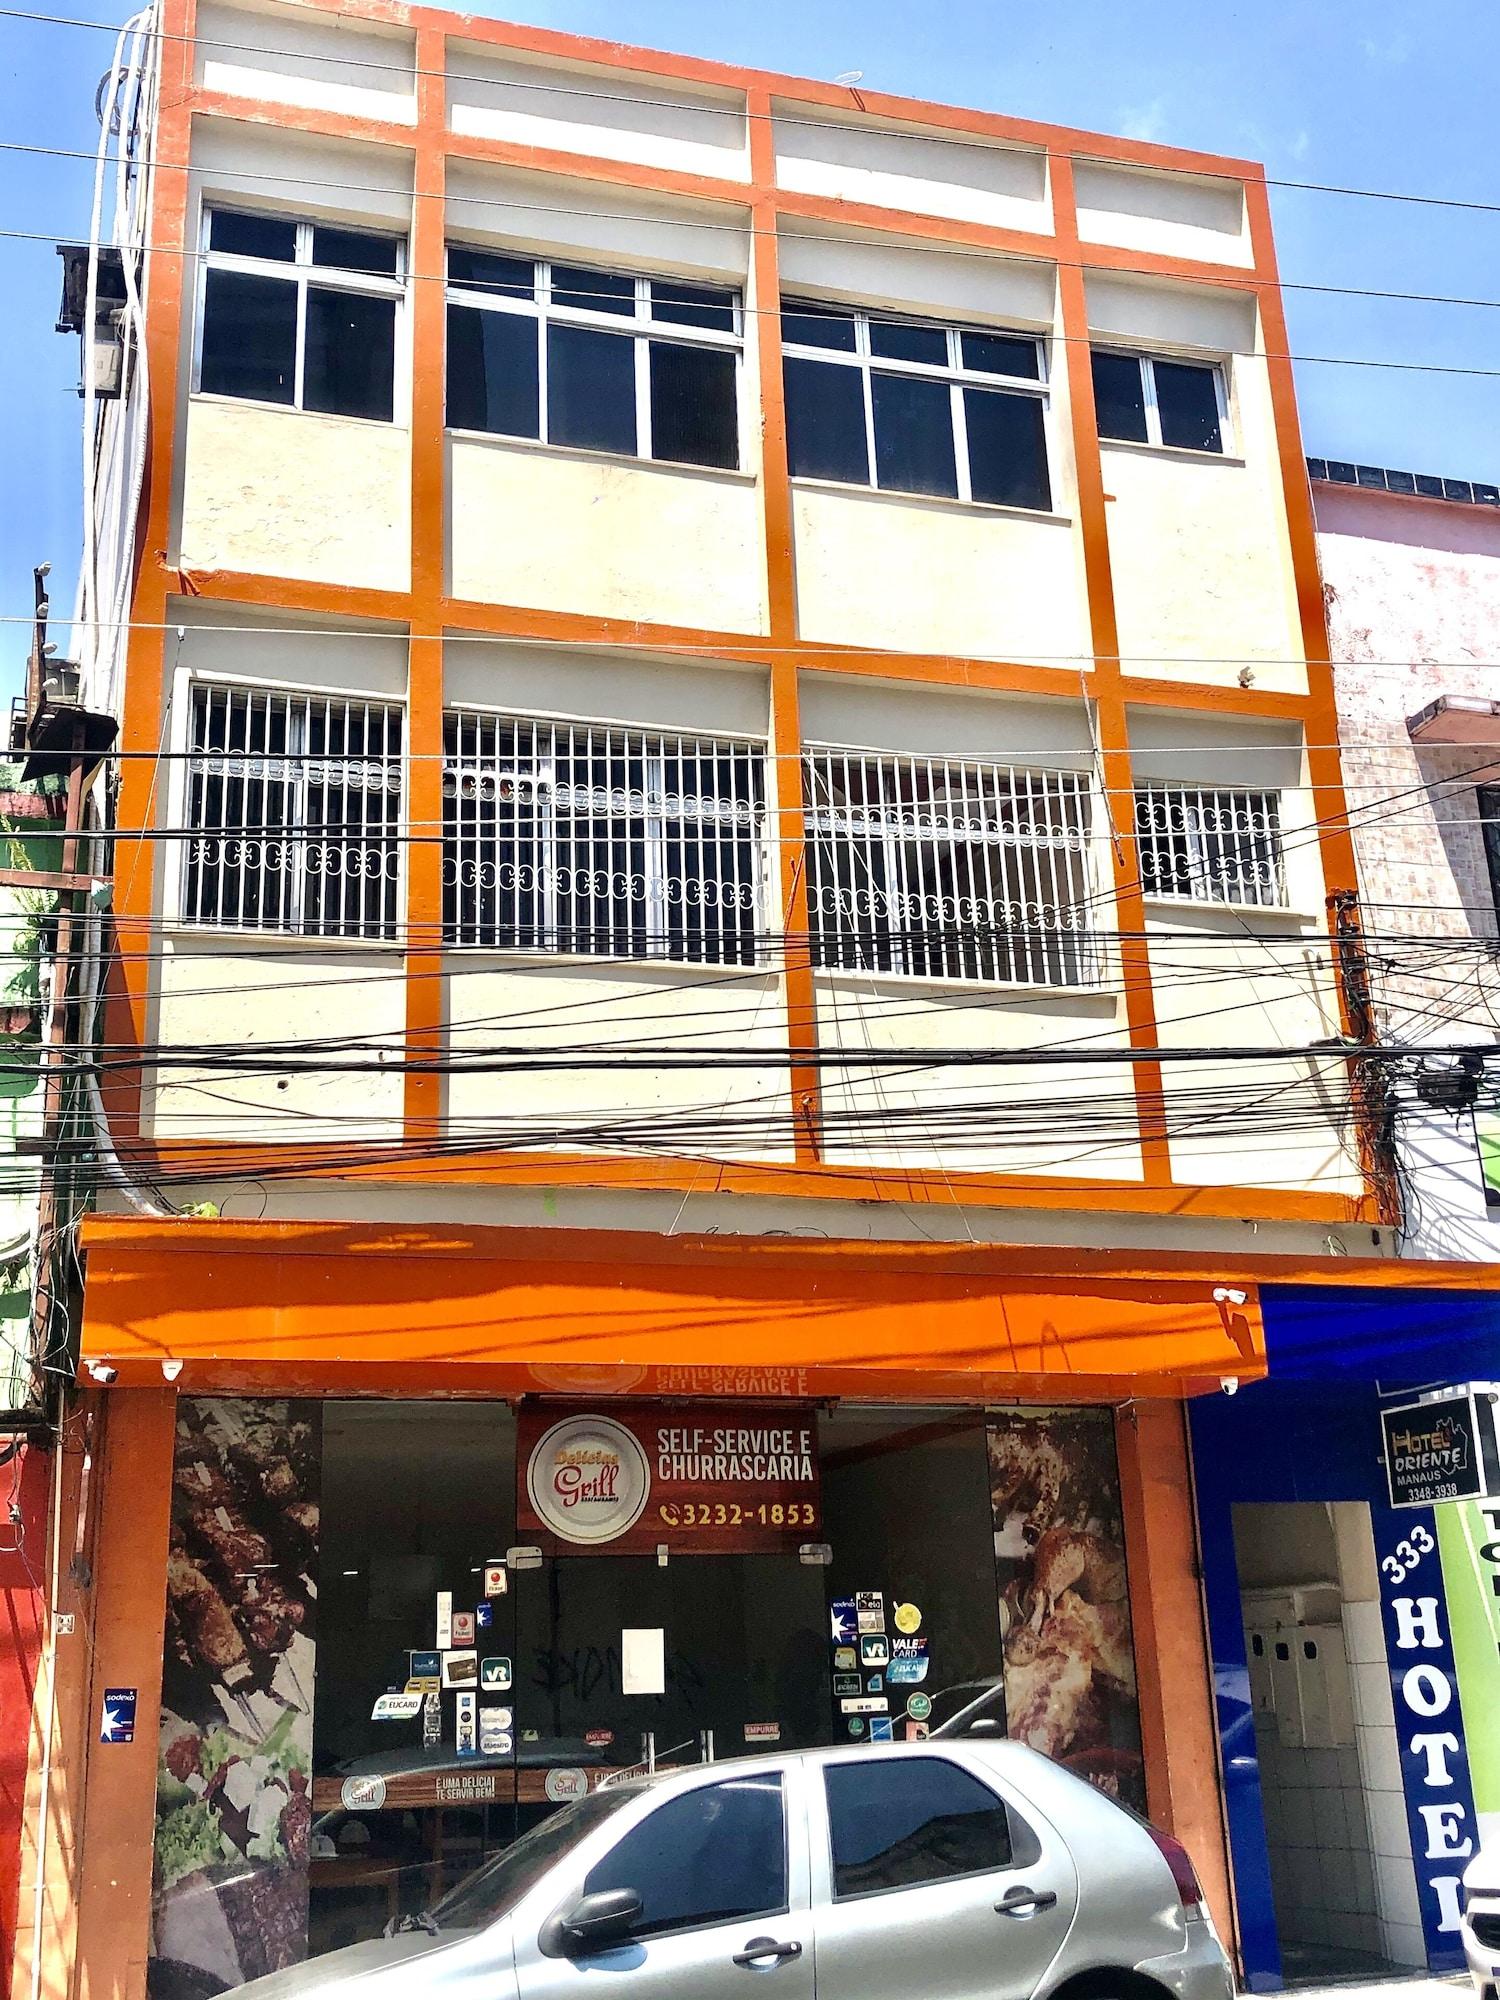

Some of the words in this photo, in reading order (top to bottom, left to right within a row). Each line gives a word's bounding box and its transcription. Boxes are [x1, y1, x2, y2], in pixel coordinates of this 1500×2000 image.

[657, 1428, 794, 1454] SELF-SERVICE
[800, 1430, 811, 1454] E
[1391, 1428, 1451, 1456] HOTEL
[658, 1454, 814, 1481] CHURRASCARIA
[1394, 1447, 1461, 1473] ORIENTE
[553, 1464, 620, 1507] Grill
[1396, 1469, 1442, 1487] MANAUS
[1408, 1482, 1458, 1502] 3348-3938
[683, 1503, 815, 1525] 3232-1853
[1382, 1525, 1435, 1585] 333
[864, 1643, 885, 1657] VR
[892, 1639, 919, 1650] VALE
[892, 1649, 918, 1658] CARD
[484, 1666, 507, 1682] VR
[745, 1724, 779, 1735] EMPURRE
[435, 1776, 443, 1789] É
[443, 1777, 461, 1789] UMA
[462, 1775, 492, 1788] DELÍCIA
[436, 1789, 446, 1800] TE
[446, 1788, 475, 1800] SERVIR
